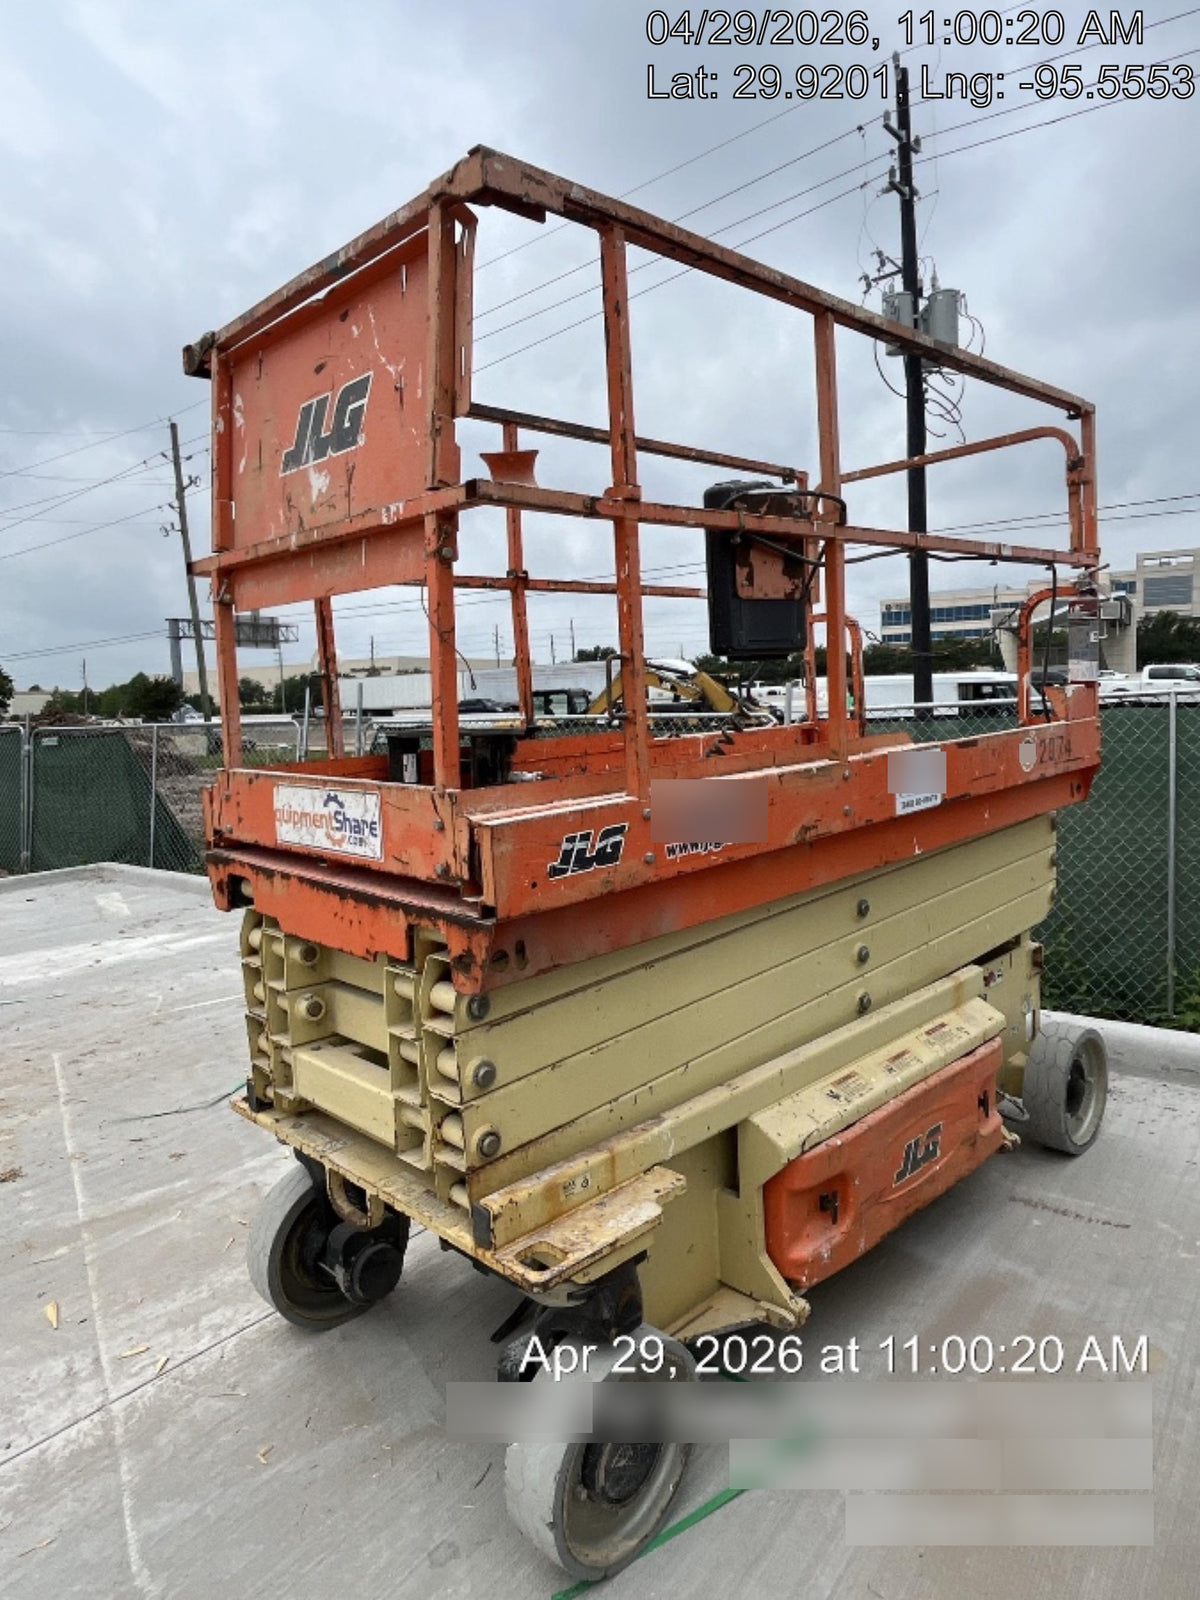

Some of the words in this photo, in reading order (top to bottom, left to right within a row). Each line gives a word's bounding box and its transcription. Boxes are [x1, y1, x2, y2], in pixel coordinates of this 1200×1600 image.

[279, 371, 374, 477] JLG
[275, 803, 378, 839] quipmentShare
[547, 823, 629, 880] JLG
[893, 1121, 943, 1187] JLG
